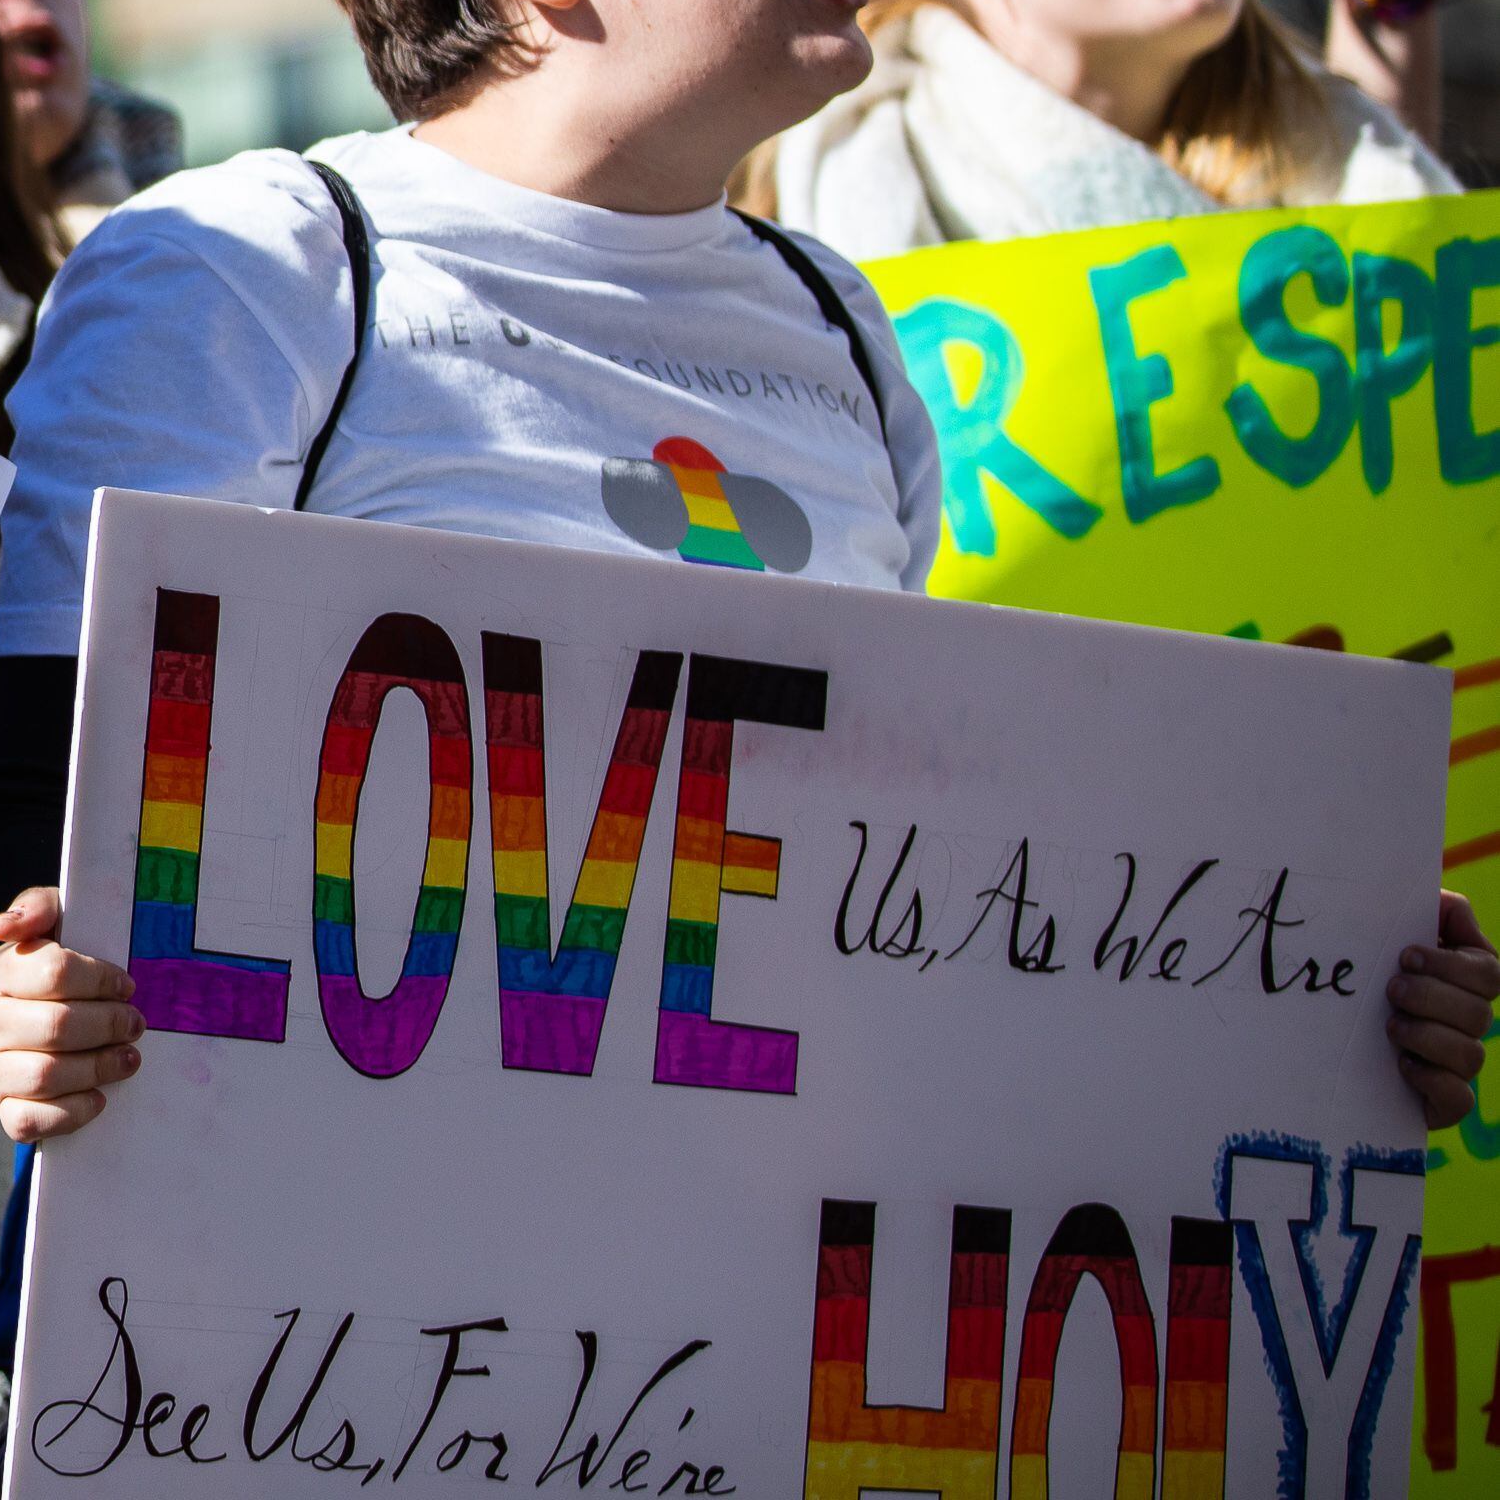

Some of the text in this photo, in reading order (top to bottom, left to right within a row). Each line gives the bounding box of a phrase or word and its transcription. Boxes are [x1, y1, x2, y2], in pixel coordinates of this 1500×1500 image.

[369, 311, 471, 349] THE
[127, 587, 1356, 1096] LOVE Us, As We Are
[32, 1277, 227, 1477] See
[242, 1308, 385, 1486] Us,
[391, 1316, 509, 1483] For
[534, 1328, 737, 1495] We're
